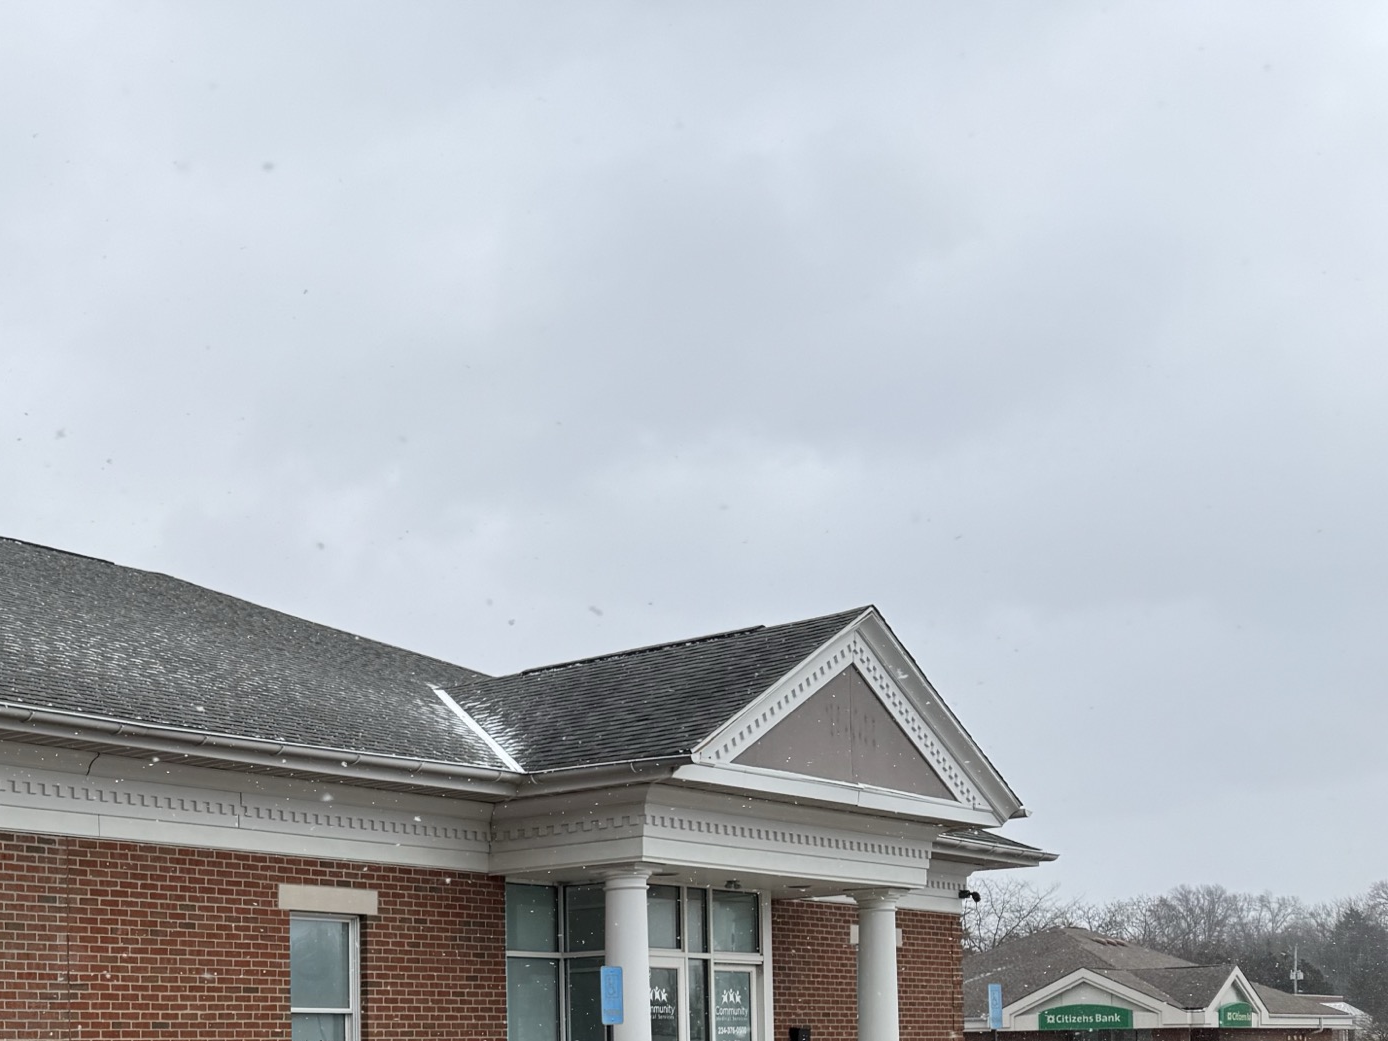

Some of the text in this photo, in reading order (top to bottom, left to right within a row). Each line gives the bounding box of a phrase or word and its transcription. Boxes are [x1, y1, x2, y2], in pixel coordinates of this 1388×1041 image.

[715, 1005, 748, 1017] Community
[1056, 1012, 1121, 1024] Citizens Bank
